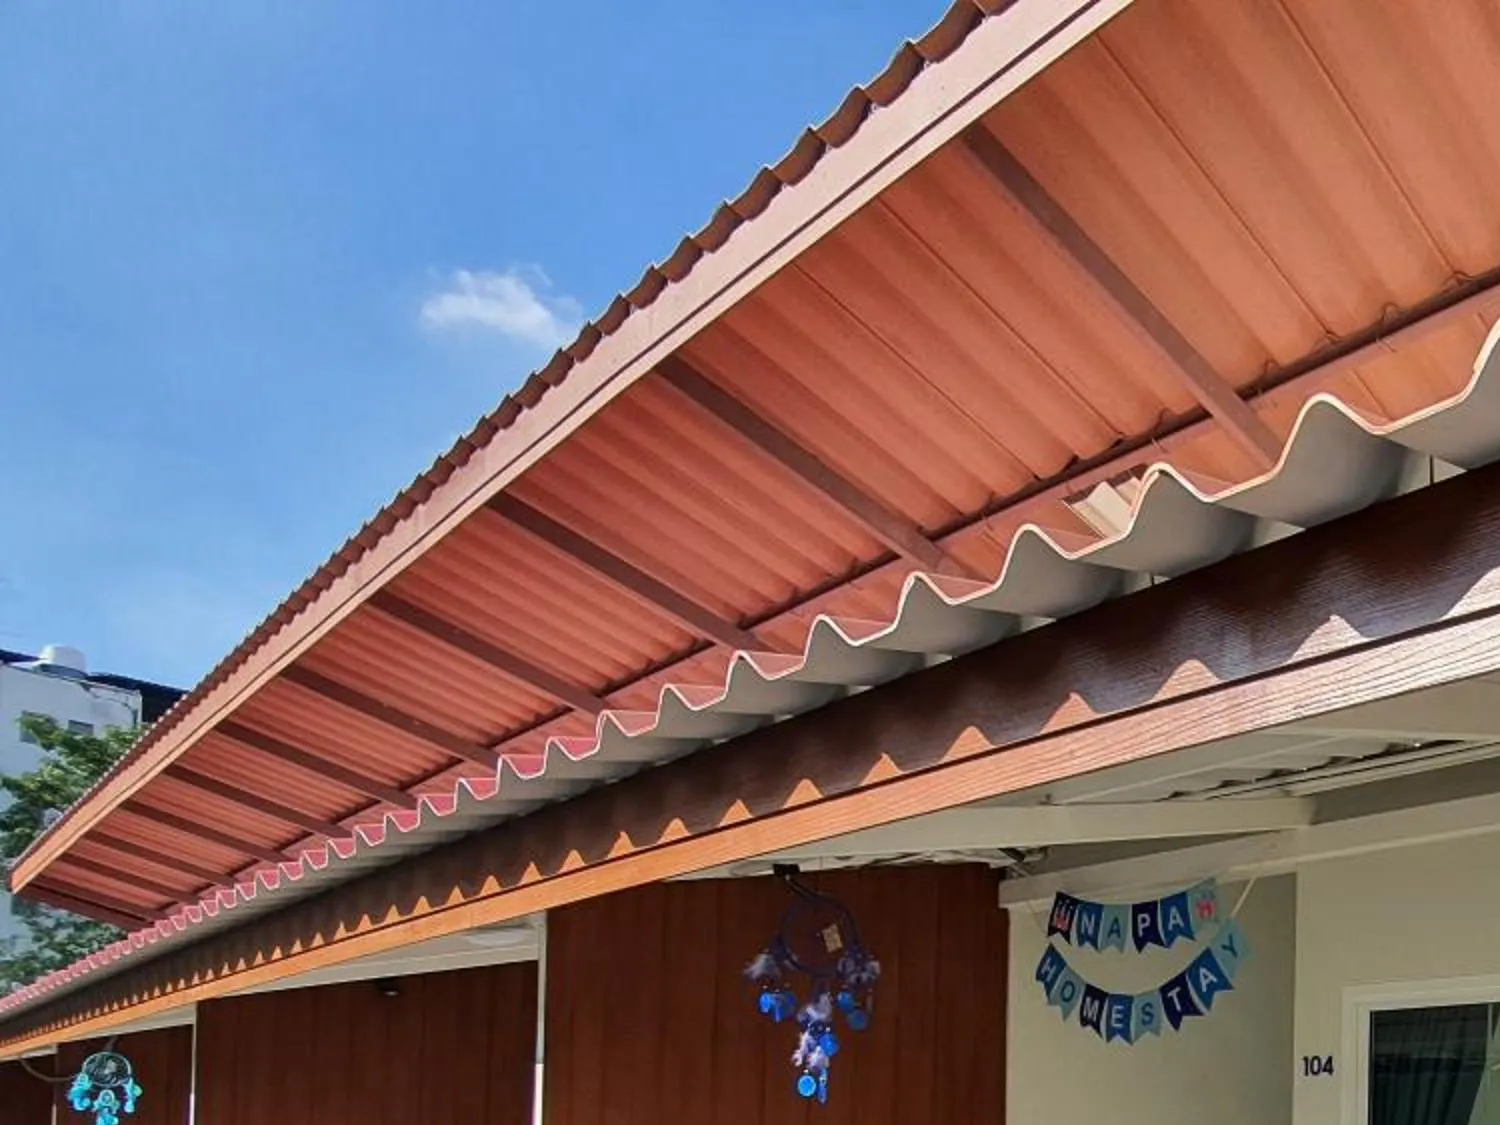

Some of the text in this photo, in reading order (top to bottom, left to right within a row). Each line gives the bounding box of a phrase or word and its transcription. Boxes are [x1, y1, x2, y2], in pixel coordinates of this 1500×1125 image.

[1079, 905, 1186, 939] NAPA
[1039, 933, 1239, 1028] HOMESTAY
[1302, 1055, 1334, 1077] 104
